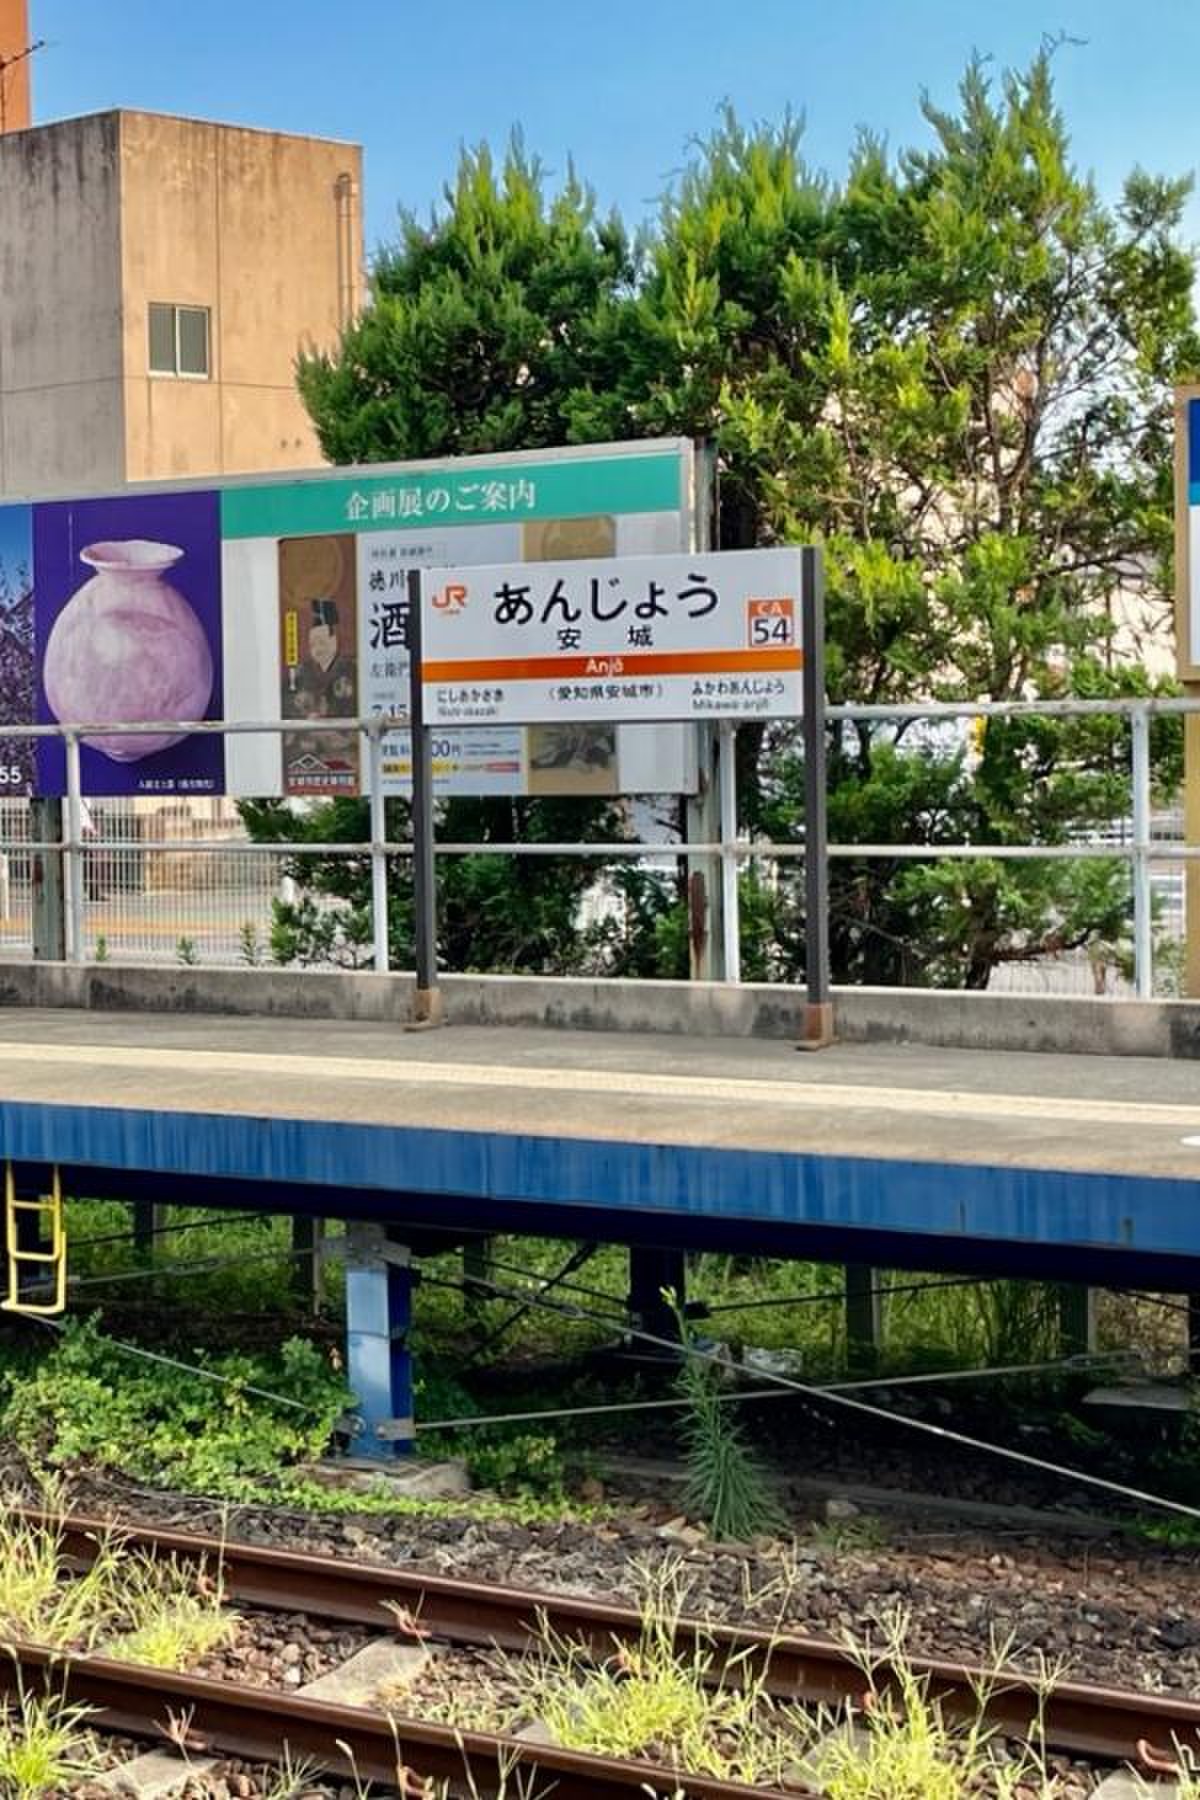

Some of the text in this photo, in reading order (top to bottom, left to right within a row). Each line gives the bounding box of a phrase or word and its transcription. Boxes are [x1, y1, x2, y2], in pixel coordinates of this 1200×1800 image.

[345, 479, 536, 522] 企画展のご案内
[432, 584, 468, 610] JR
[494, 573, 719, 626] あんじょう
[756, 603, 784, 615] CA
[754, 618, 789, 644] 54
[692, 680, 785, 696] みかわあんじょう
